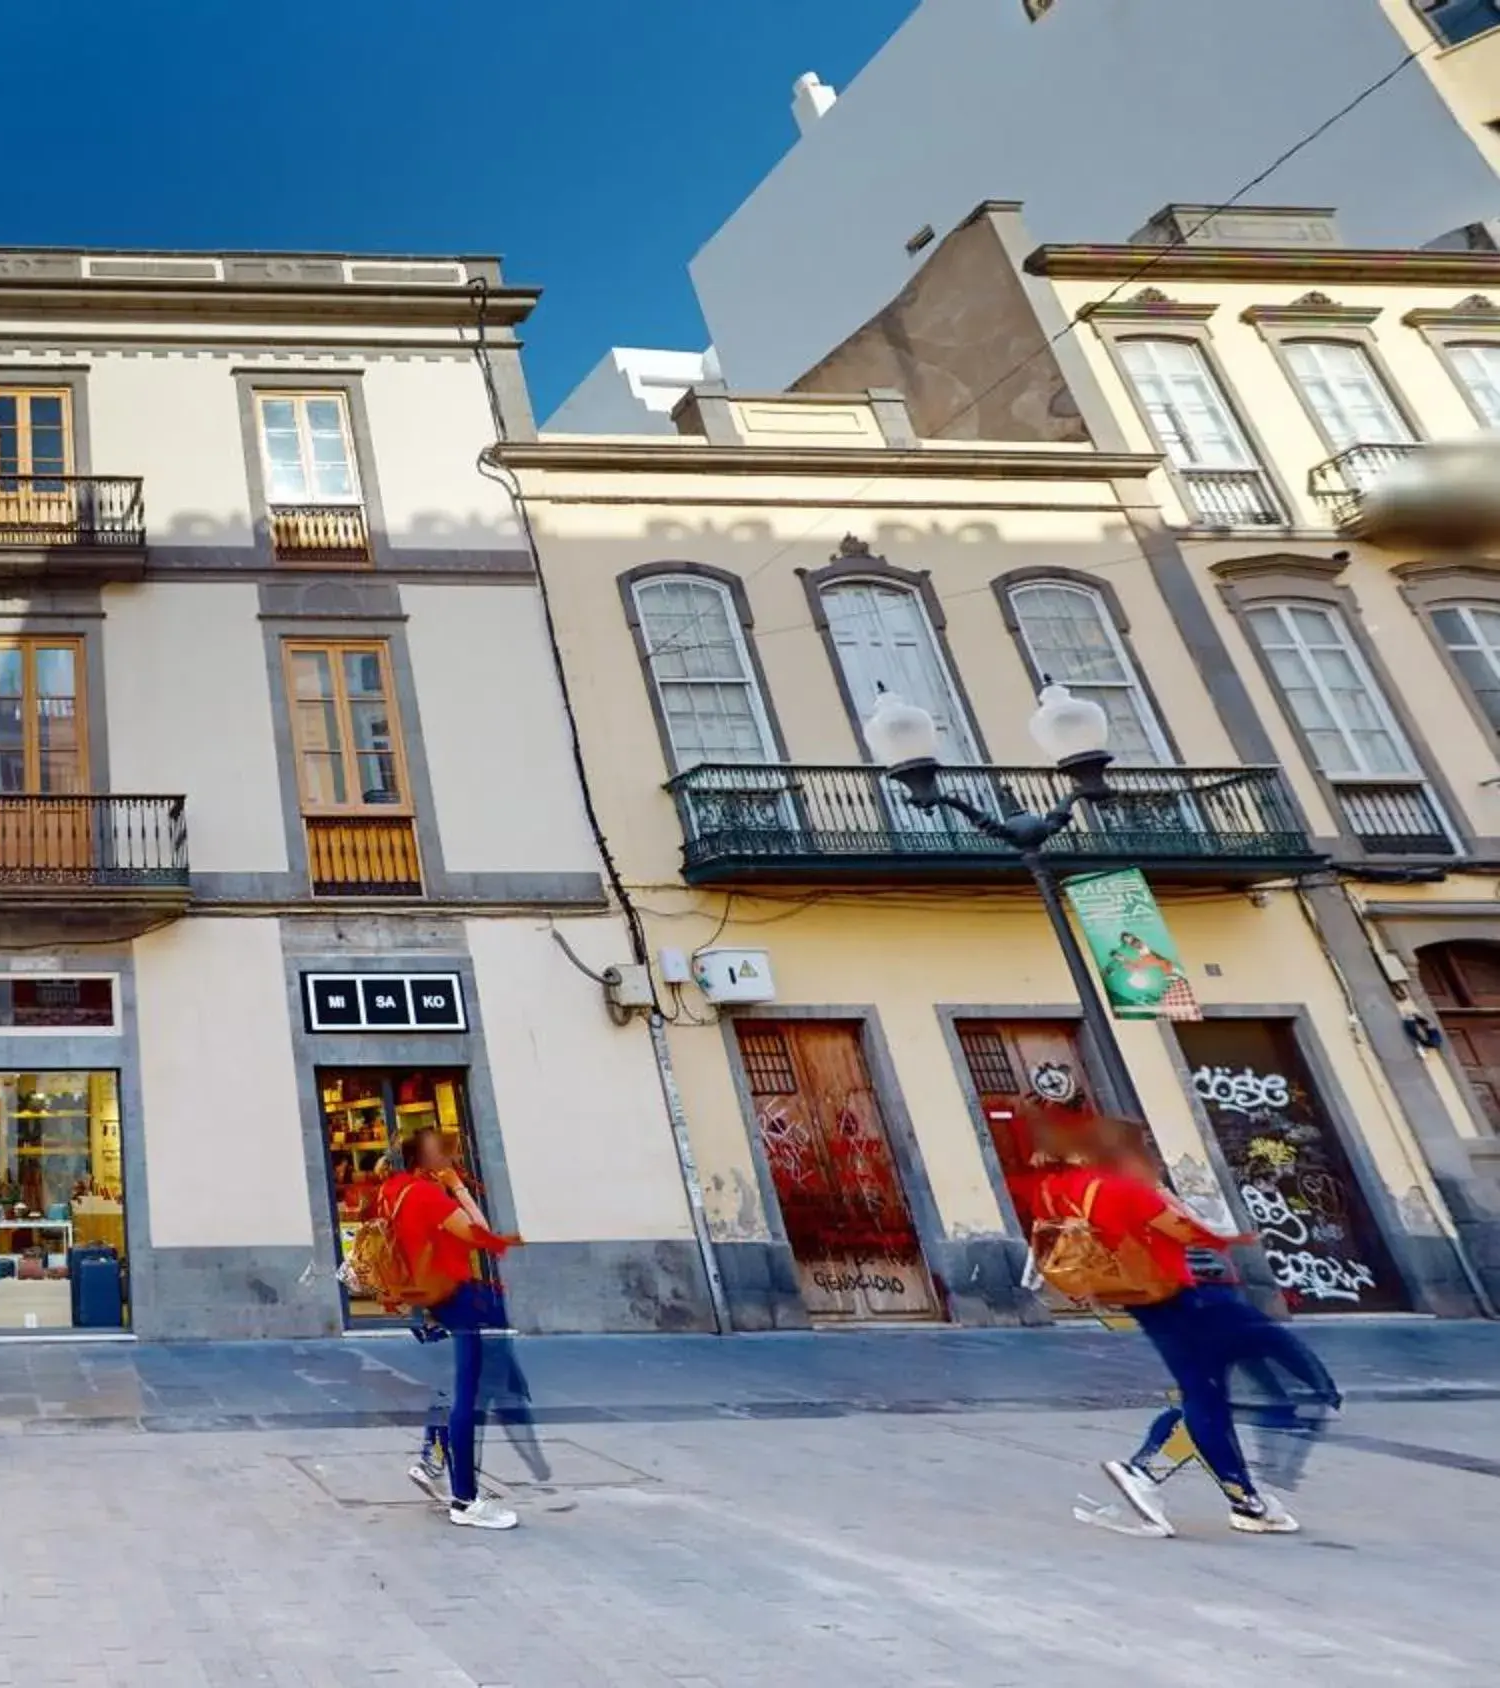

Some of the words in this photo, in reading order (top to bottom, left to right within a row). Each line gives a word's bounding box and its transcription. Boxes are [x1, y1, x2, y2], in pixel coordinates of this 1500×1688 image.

[328, 995, 347, 1009] MI
[375, 995, 396, 1009] SA
[422, 995, 446, 1008] KO
